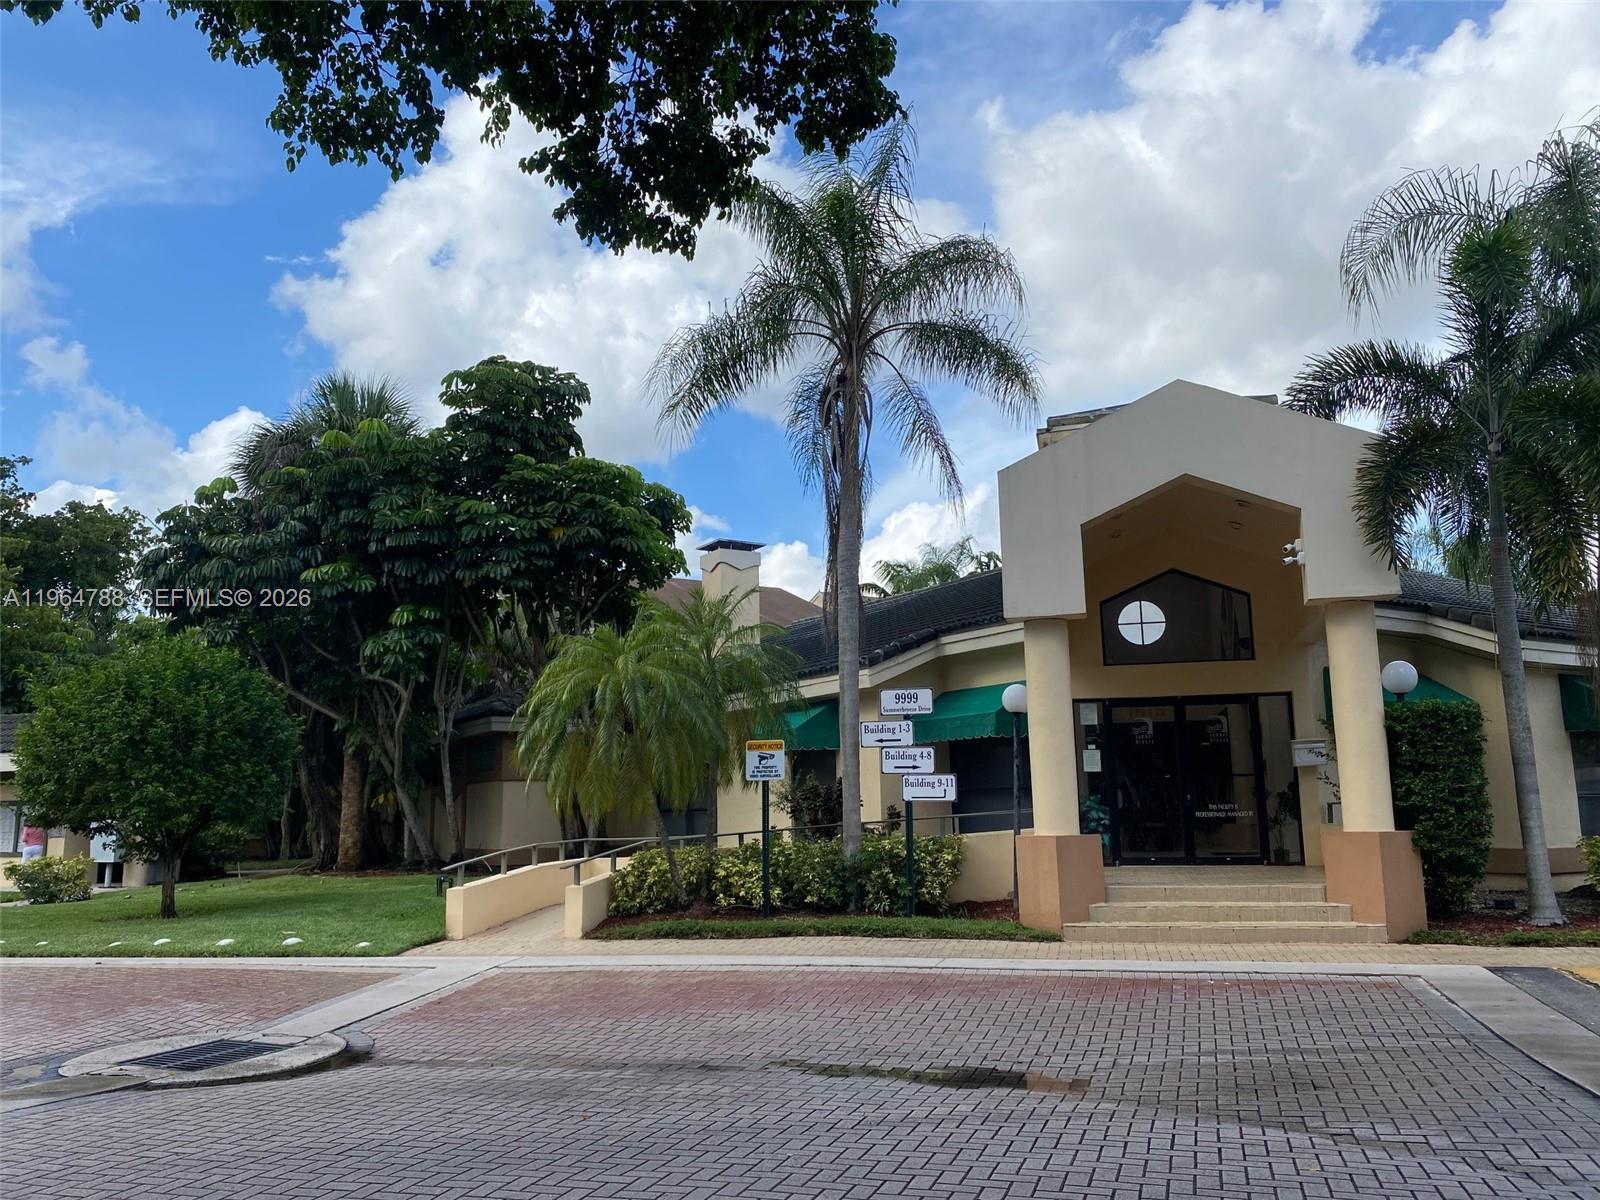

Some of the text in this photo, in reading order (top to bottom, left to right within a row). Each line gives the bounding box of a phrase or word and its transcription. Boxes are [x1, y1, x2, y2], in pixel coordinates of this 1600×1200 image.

[894, 692, 919, 704] 9999
[864, 724, 911, 735] Building 1-3
[884, 751, 932, 761] Building 4-8
[904, 778, 954, 789] Building 9-11
